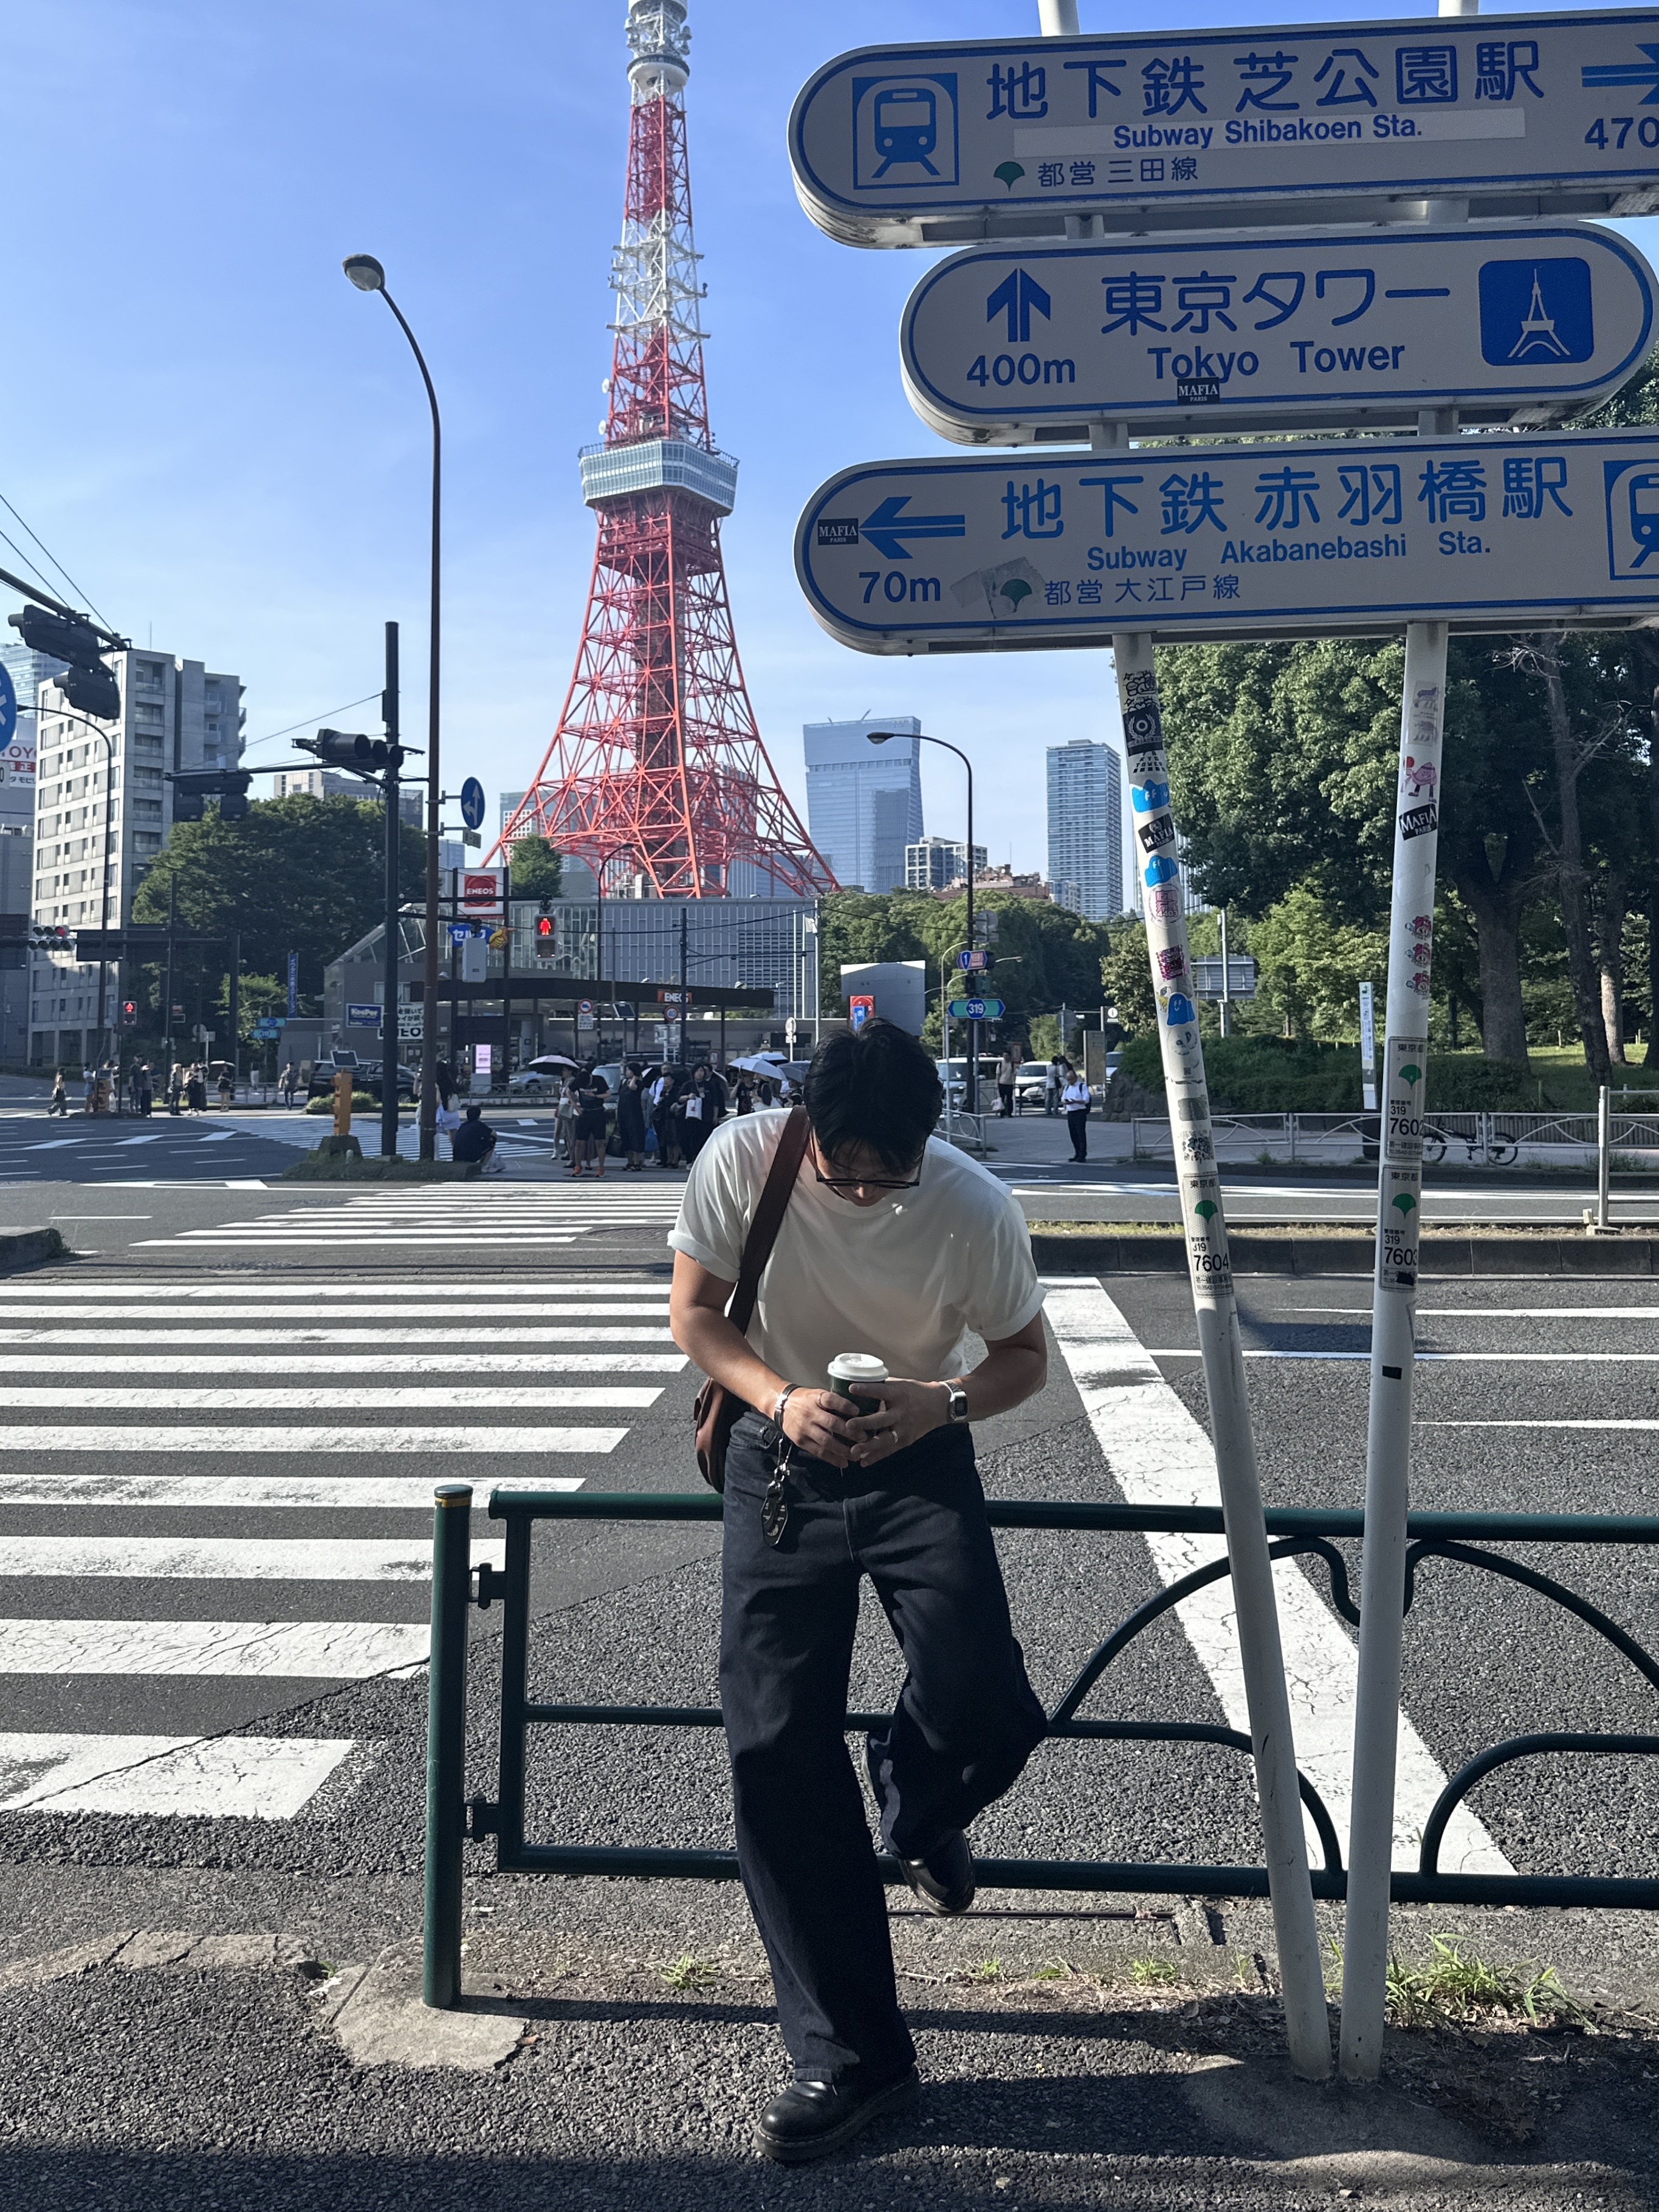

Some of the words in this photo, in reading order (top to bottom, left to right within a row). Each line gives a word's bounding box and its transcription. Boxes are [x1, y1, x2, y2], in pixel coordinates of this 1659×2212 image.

[986, 57, 1207, 120] 地下鉄
[1234, 41, 1544, 112] 芝公園駅
[1114, 125, 1213, 149] Subway
[1226, 118, 1361, 143] Shibakoen
[1373, 114, 1422, 138] Sta.
[1585, 117, 1659, 149] 470
[1038, 161, 1095, 187] 都営
[1108, 156, 1198, 183] 三田線
[1101, 271, 1450, 336] 東京タワー
[967, 353, 1075, 387] 400m
[1147, 346, 1259, 383] Tokyo
[1290, 341, 1405, 373] Tower
[1178, 384, 1218, 396] MAFIA
[1001, 472, 1228, 540] 地下鉄
[1255, 456, 1573, 531] 赤羽橋駅
[819, 525, 857, 537] MAFIA
[1087, 546, 1187, 571] Subway
[1220, 534, 1406, 564] Akabanebashi
[1439, 531, 1490, 555] Sta.
[859, 571, 941, 603] 70m
[1044, 579, 1102, 605] 都営
[1115, 574, 1240, 603] 大江戸線
[1400, 808, 1437, 833] MAFIA
[1415, 825, 1432, 835] PARIS
[1144, 827, 1173, 847] MAFIA
[964, 953, 967, 966] 1
[968, 1003, 984, 1014] 319
[1398, 1043, 1424, 1053] 東京都
[1390, 1106, 1406, 1115] 319
[1190, 1178, 1215, 1188] 東京都
[1390, 1172, 1418, 1181] 東京都
[1193, 1243, 1206, 1252] 319
[1384, 1235, 1400, 1245] 319
[1194, 1253, 1229, 1271] 7604
